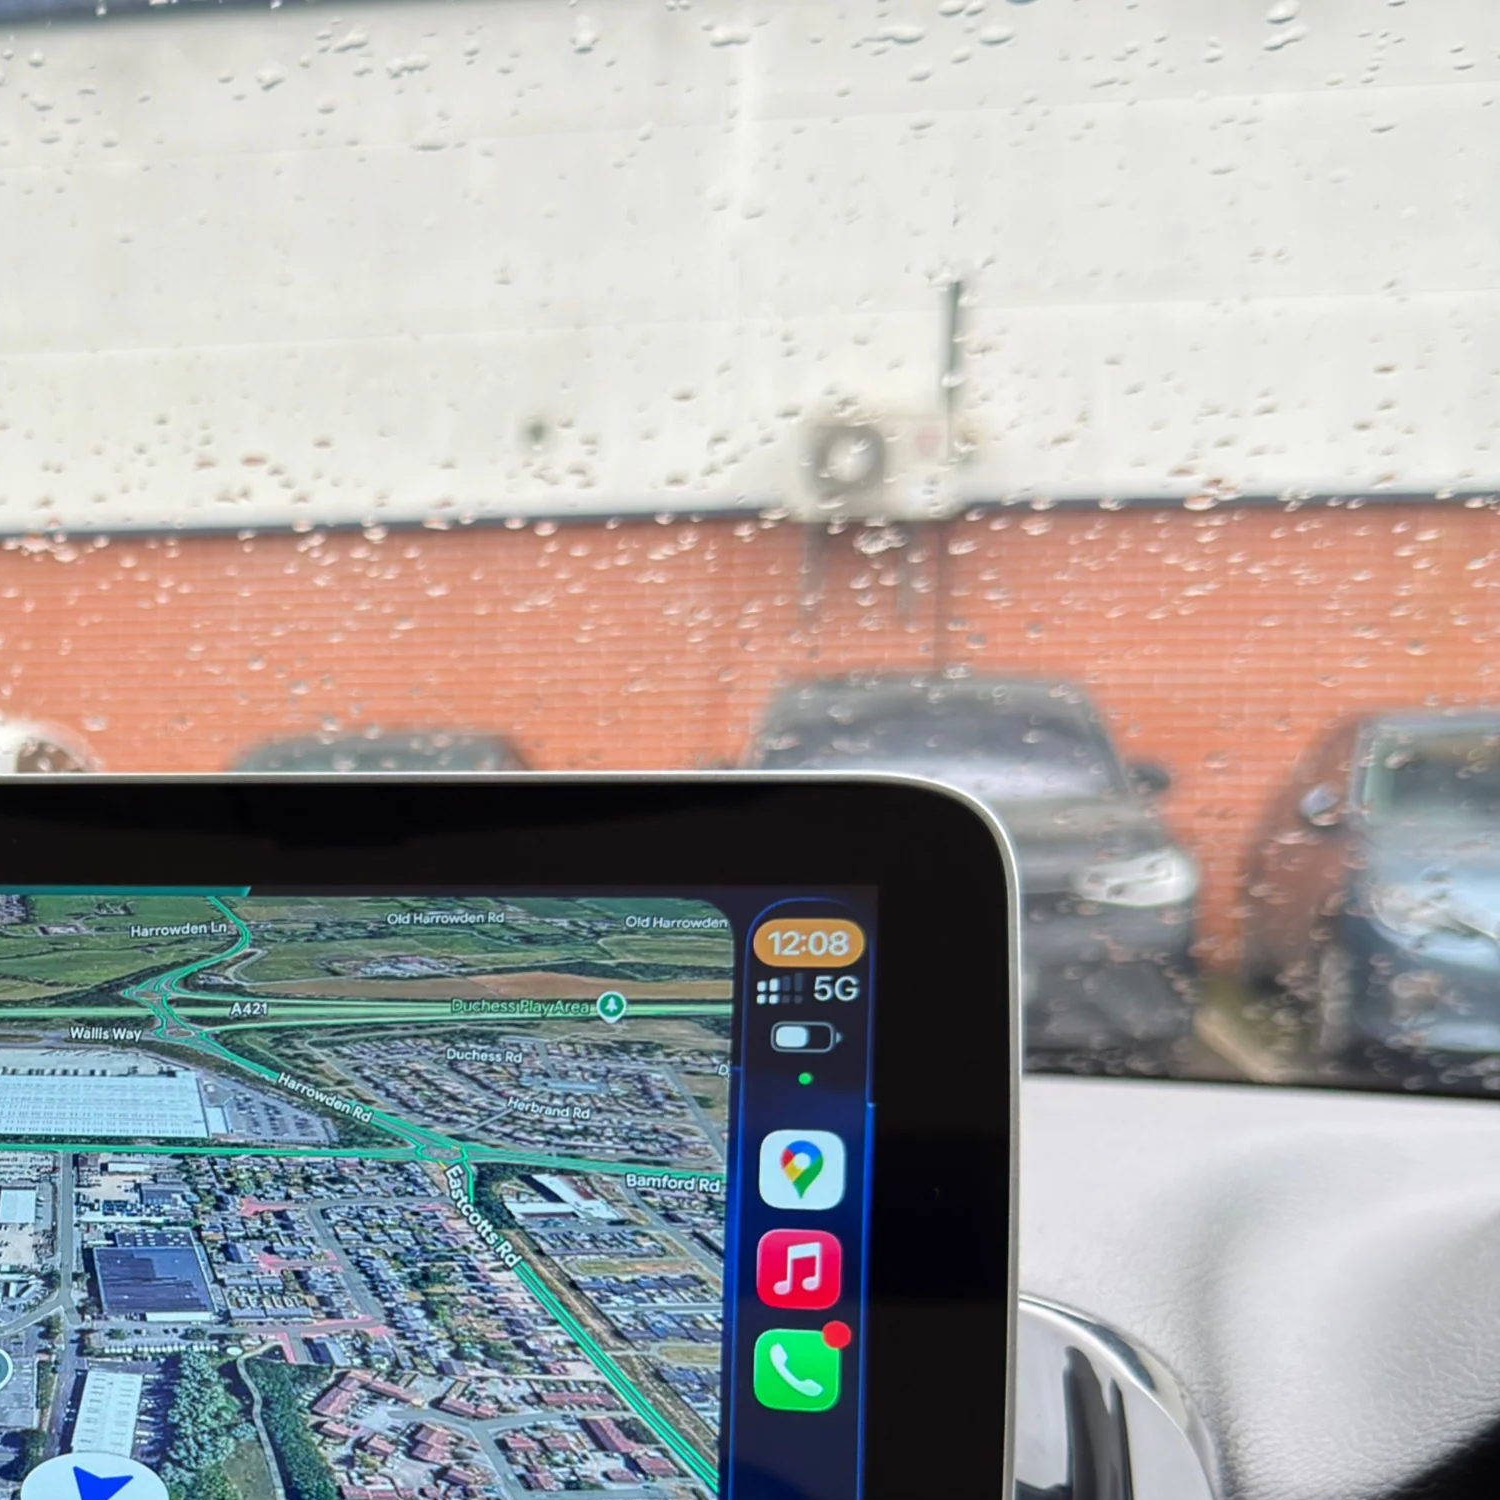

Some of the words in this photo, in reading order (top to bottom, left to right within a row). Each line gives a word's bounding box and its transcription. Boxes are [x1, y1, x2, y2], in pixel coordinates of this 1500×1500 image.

[387, 912, 410, 925] Old
[414, 912, 485, 925] Harrowden
[488, 911, 505, 923] Rd
[625, 916, 649, 929] Old
[652, 917, 728, 930] Harrowden
[130, 923, 207, 938] Harrowden
[211, 922, 227, 935] Ln
[767, 930, 849, 956] 12:08
[813, 975, 860, 1001] 5G
[230, 1003, 269, 1016] A421
[451, 999, 516, 1014] Duchess
[519, 1000, 552, 1016] Play
[554, 1001, 590, 1015] Area
[69, 1027, 109, 1041] Wallis
[112, 1027, 143, 1044] Way
[446, 1049, 502, 1063] Duchess
[505, 1051, 522, 1064] Rd
[278, 1072, 352, 1114] Harrowden
[352, 1105, 373, 1123] Rd
[507, 1096, 568, 1118] Herbrand
[571, 1105, 591, 1120] Rd
[625, 1173, 695, 1192] Bamford
[699, 1177, 721, 1193] Rd
[445, 1164, 499, 1246] Eastcotts
[496, 1240, 523, 1268] Rd
